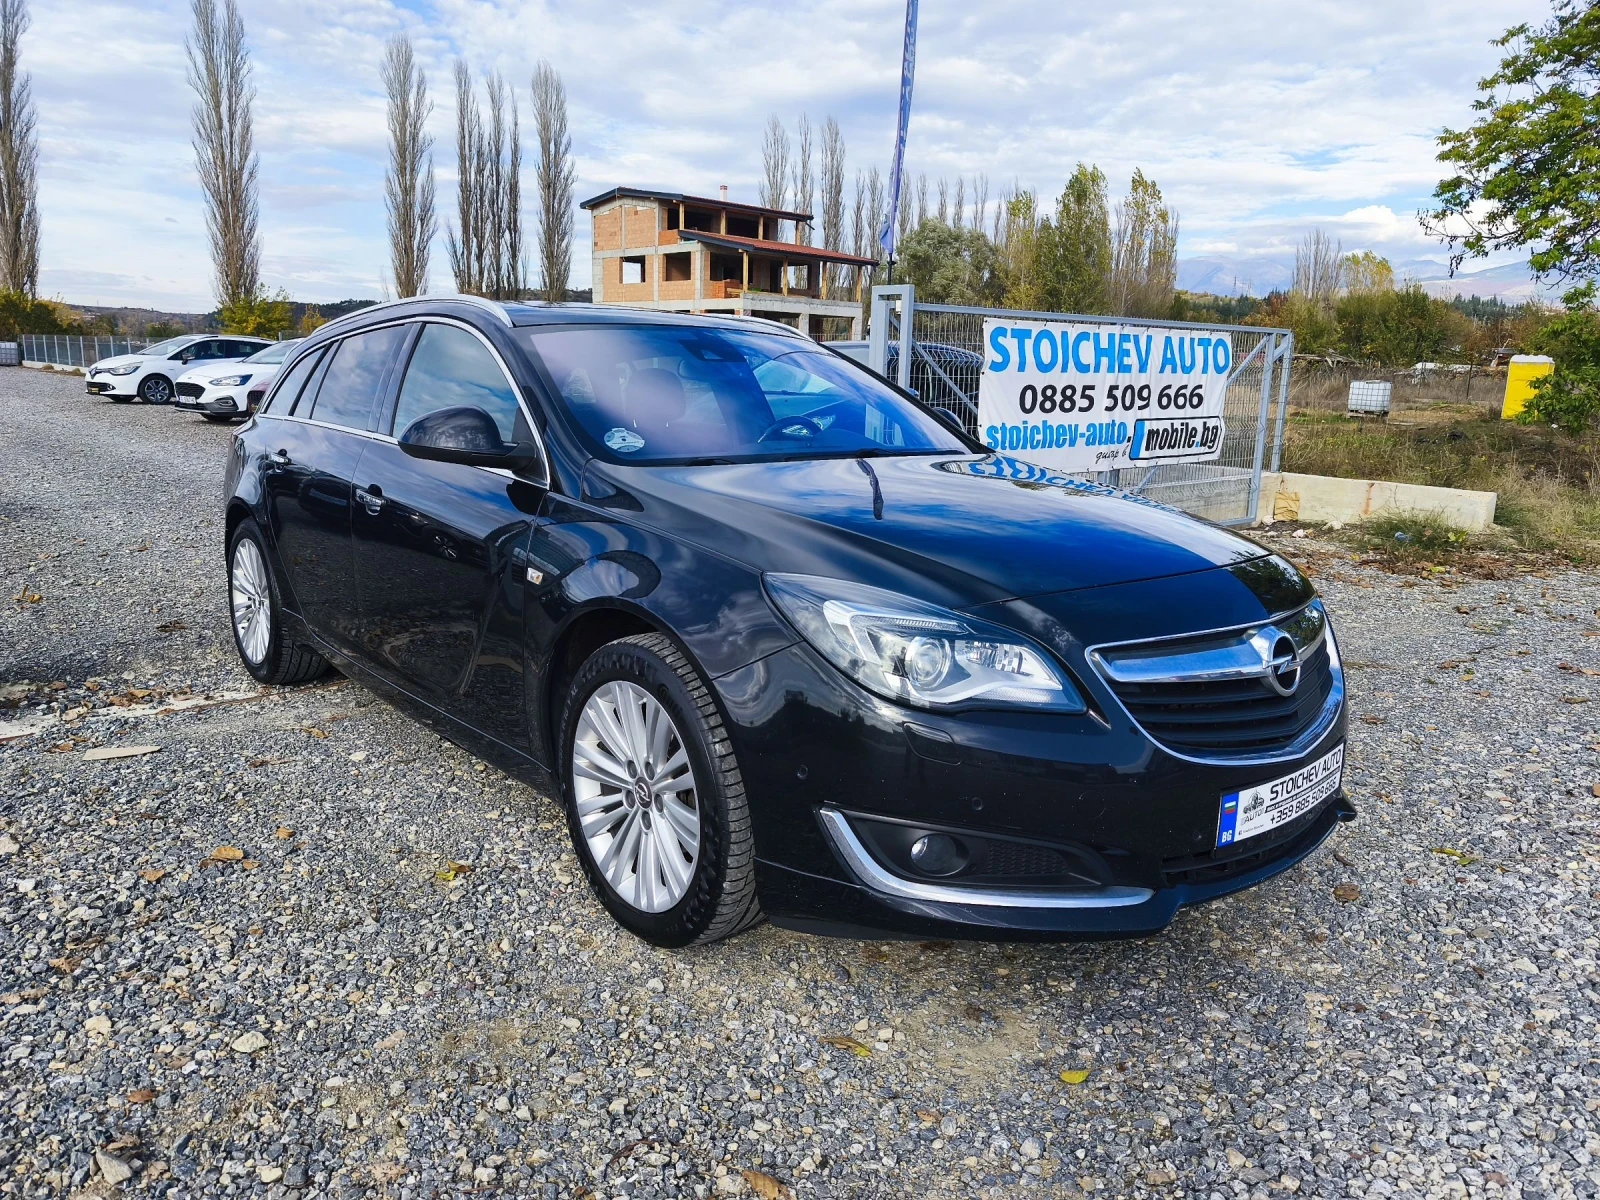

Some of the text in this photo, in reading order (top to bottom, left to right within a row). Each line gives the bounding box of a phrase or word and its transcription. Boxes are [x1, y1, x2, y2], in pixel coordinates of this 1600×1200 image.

[988, 326, 1230, 375] STOICHEV AUTO
[1019, 384, 1204, 414] 0885 509 666
[1145, 421, 1219, 452] mobile.bg
[1269, 764, 1322, 801] STOICHEV
[1321, 748, 1341, 776] AUTO
[1270, 805, 1294, 825] +359
[1294, 798, 1310, 815] 885
[1221, 830, 1233, 843] BG
